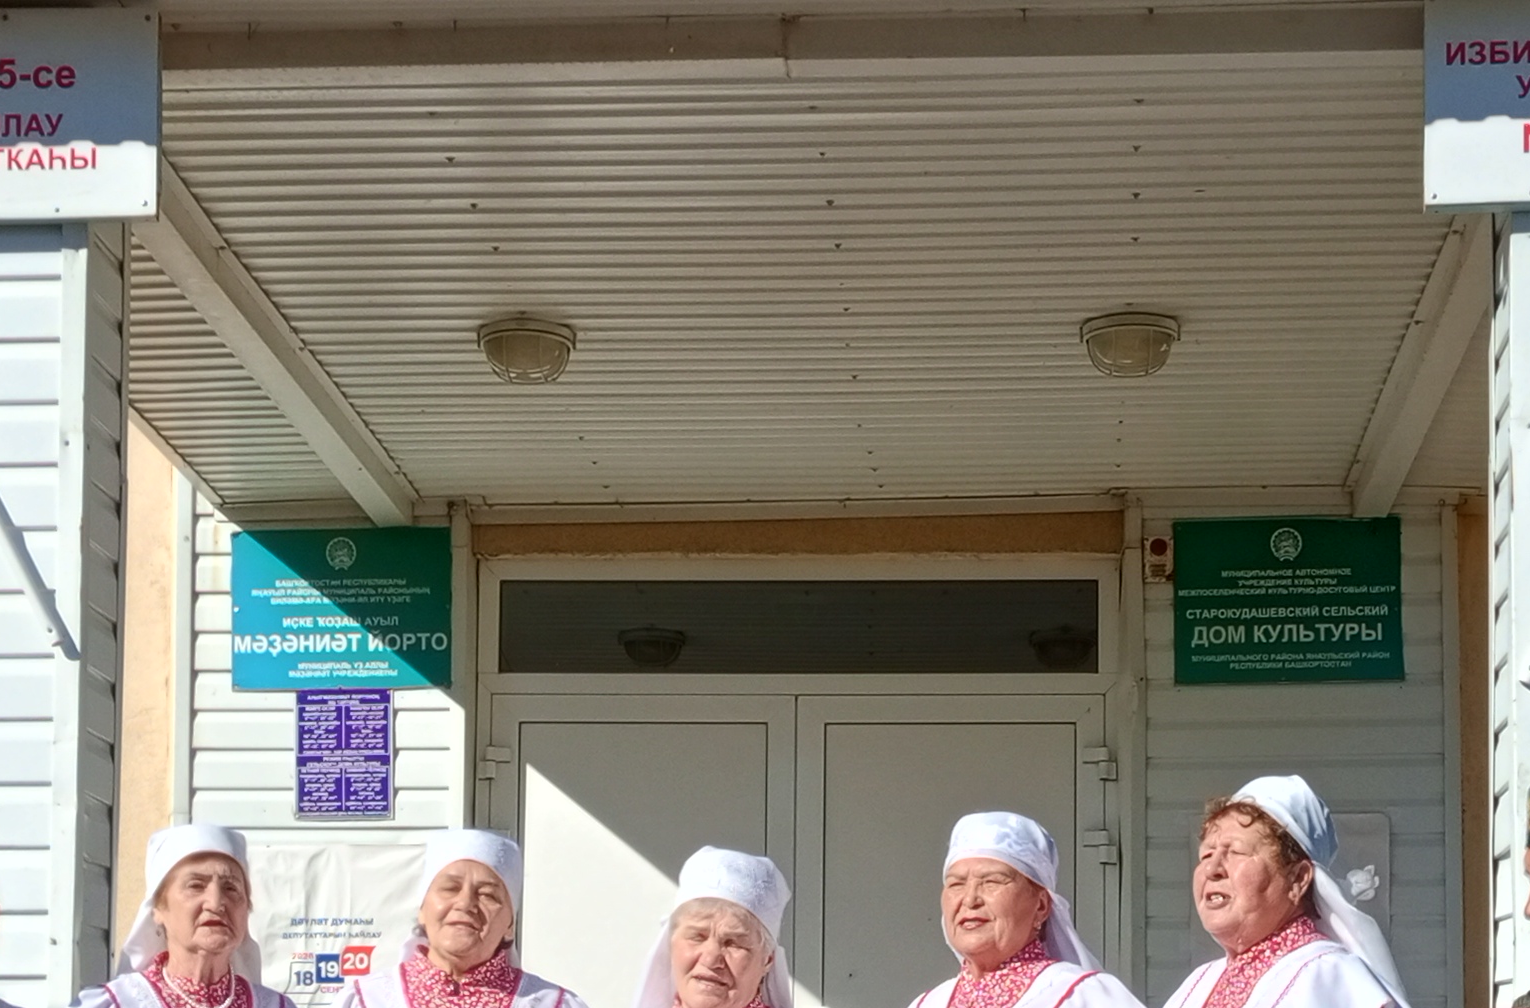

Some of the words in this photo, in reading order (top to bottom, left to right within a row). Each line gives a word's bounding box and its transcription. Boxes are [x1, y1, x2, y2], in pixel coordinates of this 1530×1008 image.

[364, 616, 399, 627] АУЫЛ
[1185, 605, 1320, 620] СТАРОКУДАШЕВСКИЙ
[1322, 604, 1389, 617] СЕЛЬСКИЙ
[233, 633, 363, 657] МӘҘӘНИӘТ
[368, 629, 449, 652] ЙОРТО
[1191, 625, 1246, 648] ДОМ
[1253, 622, 1383, 643] КУЛЬТУРЫ
[294, 970, 314, 987] 18
[318, 960, 340, 979] 19
[342, 952, 370, 971] 20
